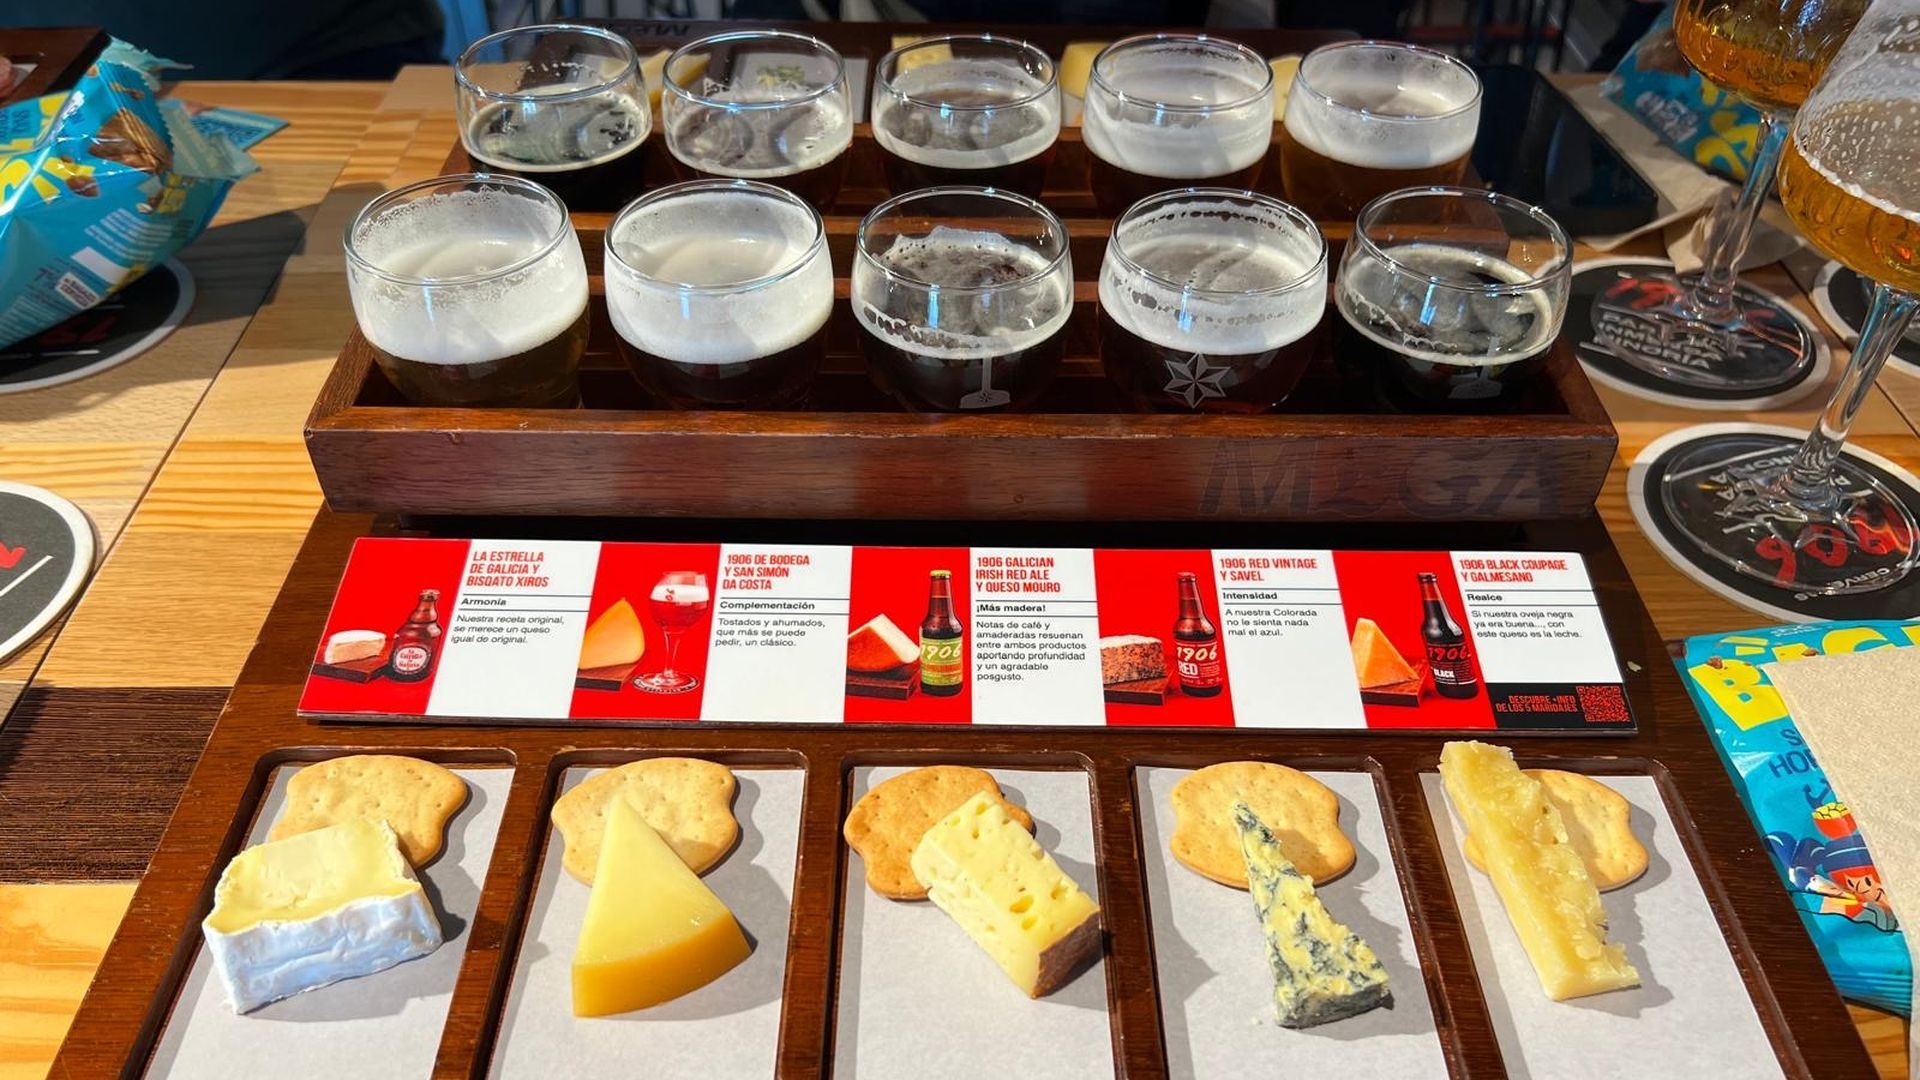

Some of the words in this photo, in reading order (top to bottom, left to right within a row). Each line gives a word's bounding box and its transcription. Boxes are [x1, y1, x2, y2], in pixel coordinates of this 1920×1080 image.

[473, 551, 487, 562] LA
[490, 551, 544, 562] ESTRELLA
[727, 554, 752, 565] 1906
[754, 554, 768, 565] DE
[770, 555, 810, 565] BODEGA
[977, 557, 1002, 568] 1906
[1005, 557, 1054, 568] GALICIAN
[1220, 558, 1246, 568] 1906
[1249, 558, 1270, 569] RED
[1272, 559, 1317, 569] VINTAGE
[1460, 560, 1485, 570] 1906
[1487, 560, 1520, 570] BLACK
[1521, 560, 1568, 571] COUPAGE
[469, 564, 485, 574] DE
[486, 564, 530, 574] GALICIA
[531, 564, 540, 574] Y
[725, 567, 732, 577] Y
[733, 567, 755, 577] SAN
[756, 565, 789, 578] SIMÓN
[976, 570, 1004, 580] IRISH
[1006, 570, 1027, 580] RED
[1030, 570, 1049, 580] ALE
[1220, 571, 1228, 581] Y
[1230, 571, 1264, 581] SAVEL
[1462, 572, 1469, 582] Y
[1471, 572, 1533, 582] GALMESANO
[515, 576, 550, 587] XIROS
[723, 579, 737, 590] DA
[739, 579, 772, 590] COSTA
[976, 582, 984, 592] Y
[986, 582, 1020, 593] QUESO
[1023, 582, 1061, 593] MOURO
[1223, 592, 1278, 600] Intensidad
[720, 601, 815, 612] Complementación
[976, 604, 1001, 613] ¡Más
[1003, 604, 1046, 612] madera!
[1273, 608, 1317, 616] Colorada
[1471, 610, 1482, 618] Si
[1520, 611, 1545, 620] oveja
[1547, 612, 1573, 620] negra
[456, 615, 494, 623] Nuestra
[527, 615, 564, 626] original,
[719, 618, 762, 627] Tostados
[763, 620, 769, 628] y
[772, 618, 825, 628] ahumados,
[1241, 618, 1251, 626] le
[1253, 618, 1282, 626] sienta
[521, 626, 551, 635] queso
[976, 621, 1004, 629] Notas
[1006, 621, 1019, 629] de
[1022, 621, 1042, 629] café
[1045, 623, 1050, 631] y
[1474, 622, 1486, 630] ya
[716, 630, 735, 638] que
[775, 629, 806, 638] puede
[976, 631, 1036, 639] amaderadas
[1228, 628, 1246, 636] mal
[1249, 628, 1257, 636] el
[1499, 631, 1528, 640] queso
[1544, 630, 1553, 638] la
[1554, 630, 1583, 638] leche.
[451, 635, 475, 644] igual
[490, 635, 528, 645] original.
[715, 638, 742, 647] pedir,
[760, 638, 796, 647] clásico.
[921, 643, 962, 660] 1906
[976, 642, 1001, 650] entre
[1004, 641, 1036, 650] ambos
[1039, 641, 1087, 652] productos
[976, 652, 1025, 662] aportando
[1028, 652, 1085, 662] profundidad
[1177, 644, 1217, 661] 1906
[1428, 645, 1467, 661] 1906
[976, 664, 982, 672] y
[1000, 662, 1049, 672] agradable
[976, 672, 1024, 682] posgusto.
[1508, 695, 1551, 704] DESCUBRE
[1495, 703, 1508, 712] DE
[1508, 703, 1524, 712] LOS
[1531, 704, 1578, 712] MARIDAJES
